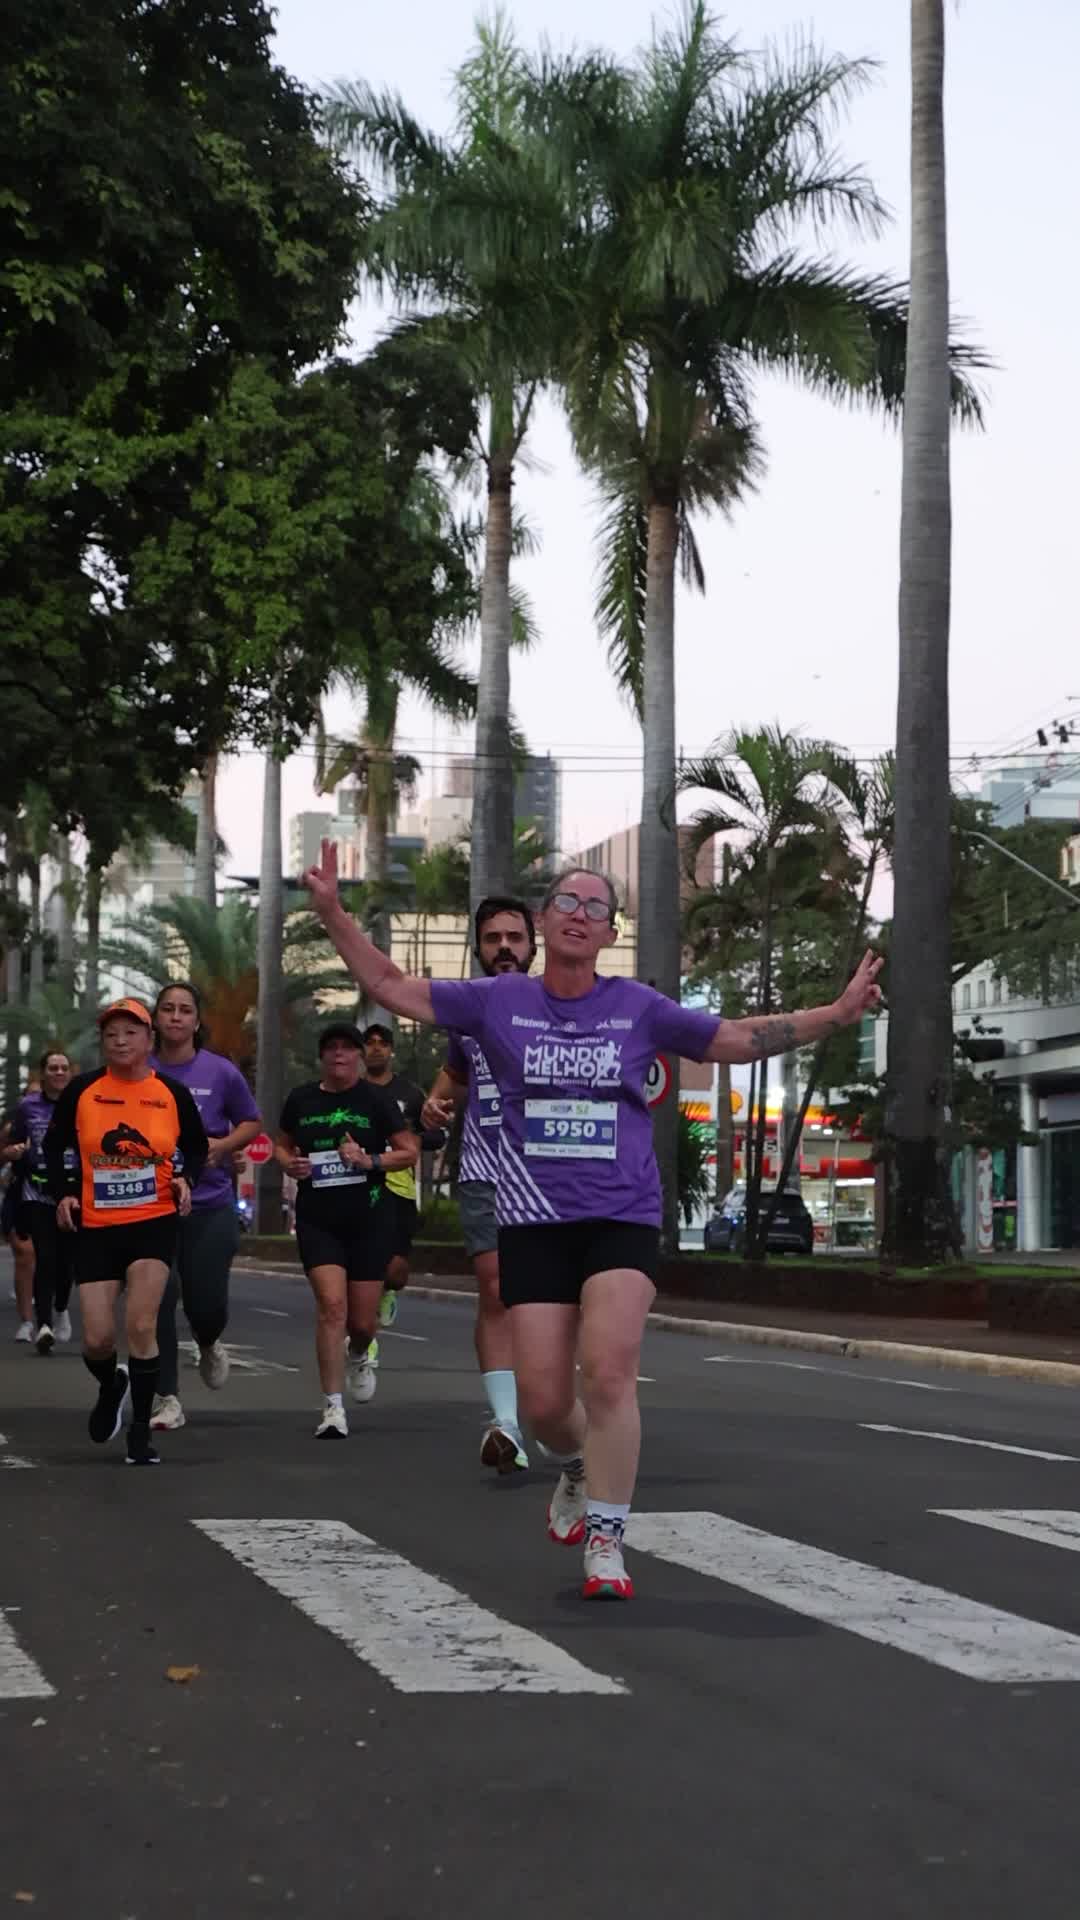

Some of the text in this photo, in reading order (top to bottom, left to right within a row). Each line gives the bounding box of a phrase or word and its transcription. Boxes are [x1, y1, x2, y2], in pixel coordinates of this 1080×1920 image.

[525, 1044, 608, 1063] MUNDO
[523, 1060, 608, 1079] MELHOR
[543, 1119, 597, 1138] 5950
[246, 1143, 269, 1153] PARE
[107, 1182, 144, 1195] 5348
